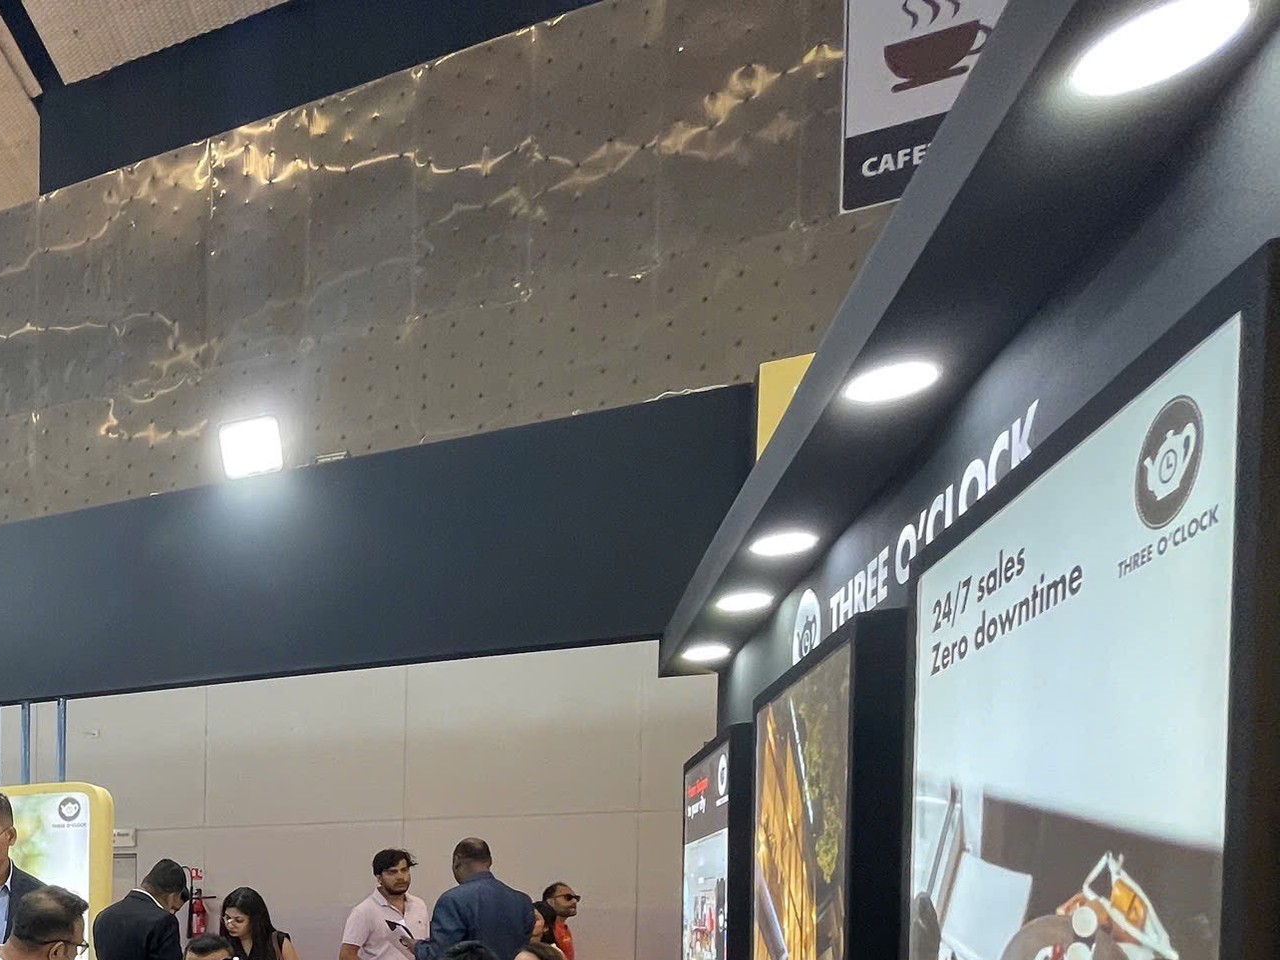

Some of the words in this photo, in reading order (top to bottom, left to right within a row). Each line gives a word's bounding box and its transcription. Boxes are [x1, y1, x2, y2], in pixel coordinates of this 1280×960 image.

[861, 143, 931, 177] CAFE
[1118, 544, 1153, 578] THREE
[1157, 504, 1219, 555] O'CLOCK
[829, 546, 889, 633] THREE
[930, 642, 968, 676] Zero
[974, 564, 1083, 650] downtime
[932, 576, 973, 633] 24/7
[977, 547, 1025, 603] sales
